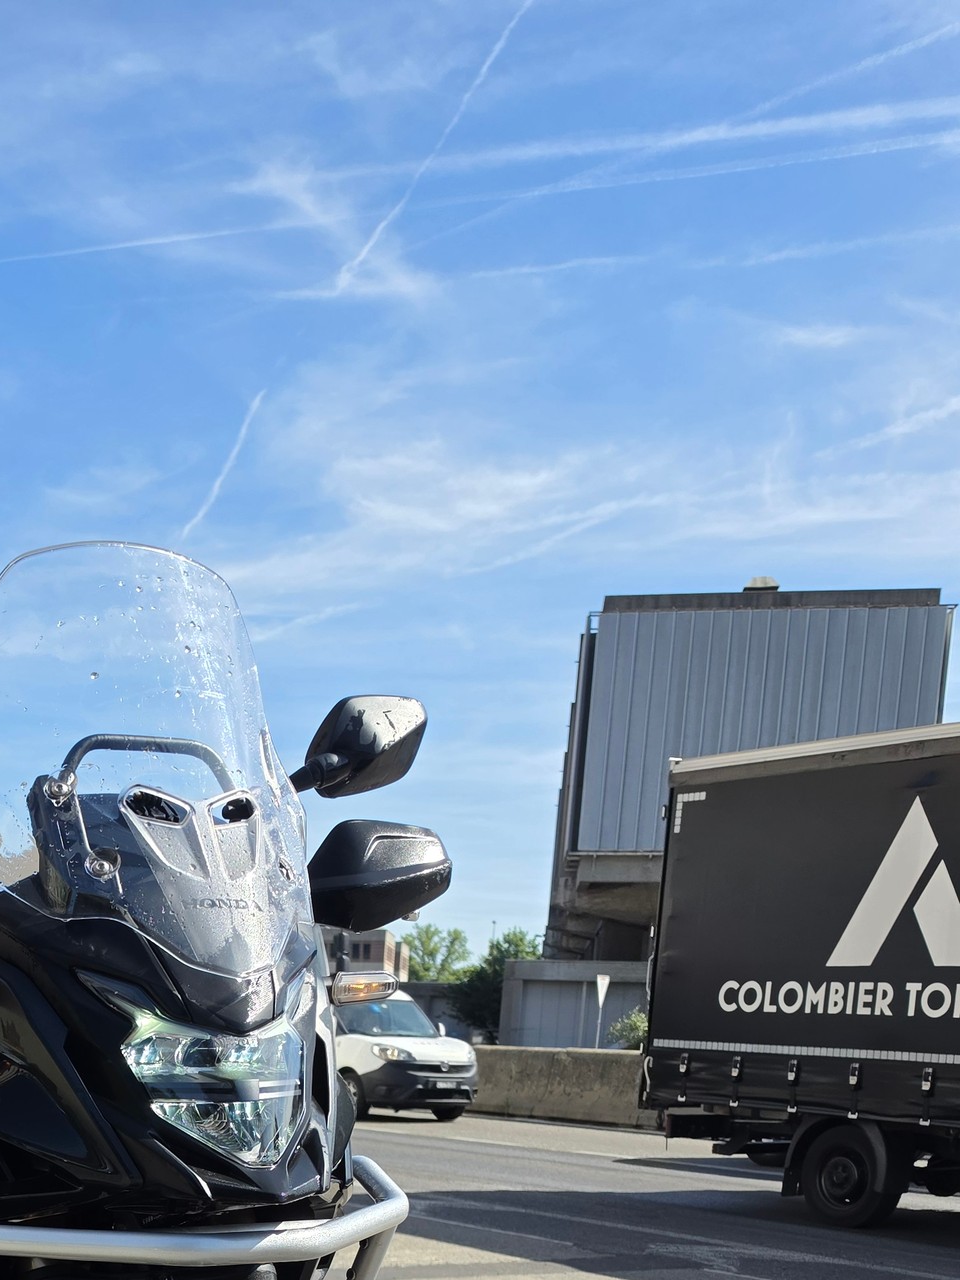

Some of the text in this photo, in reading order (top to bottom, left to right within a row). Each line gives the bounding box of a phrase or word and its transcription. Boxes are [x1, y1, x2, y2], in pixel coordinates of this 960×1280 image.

[181, 898, 264, 912] HONDA
[718, 980, 960, 1019] COLOMBIER TO
